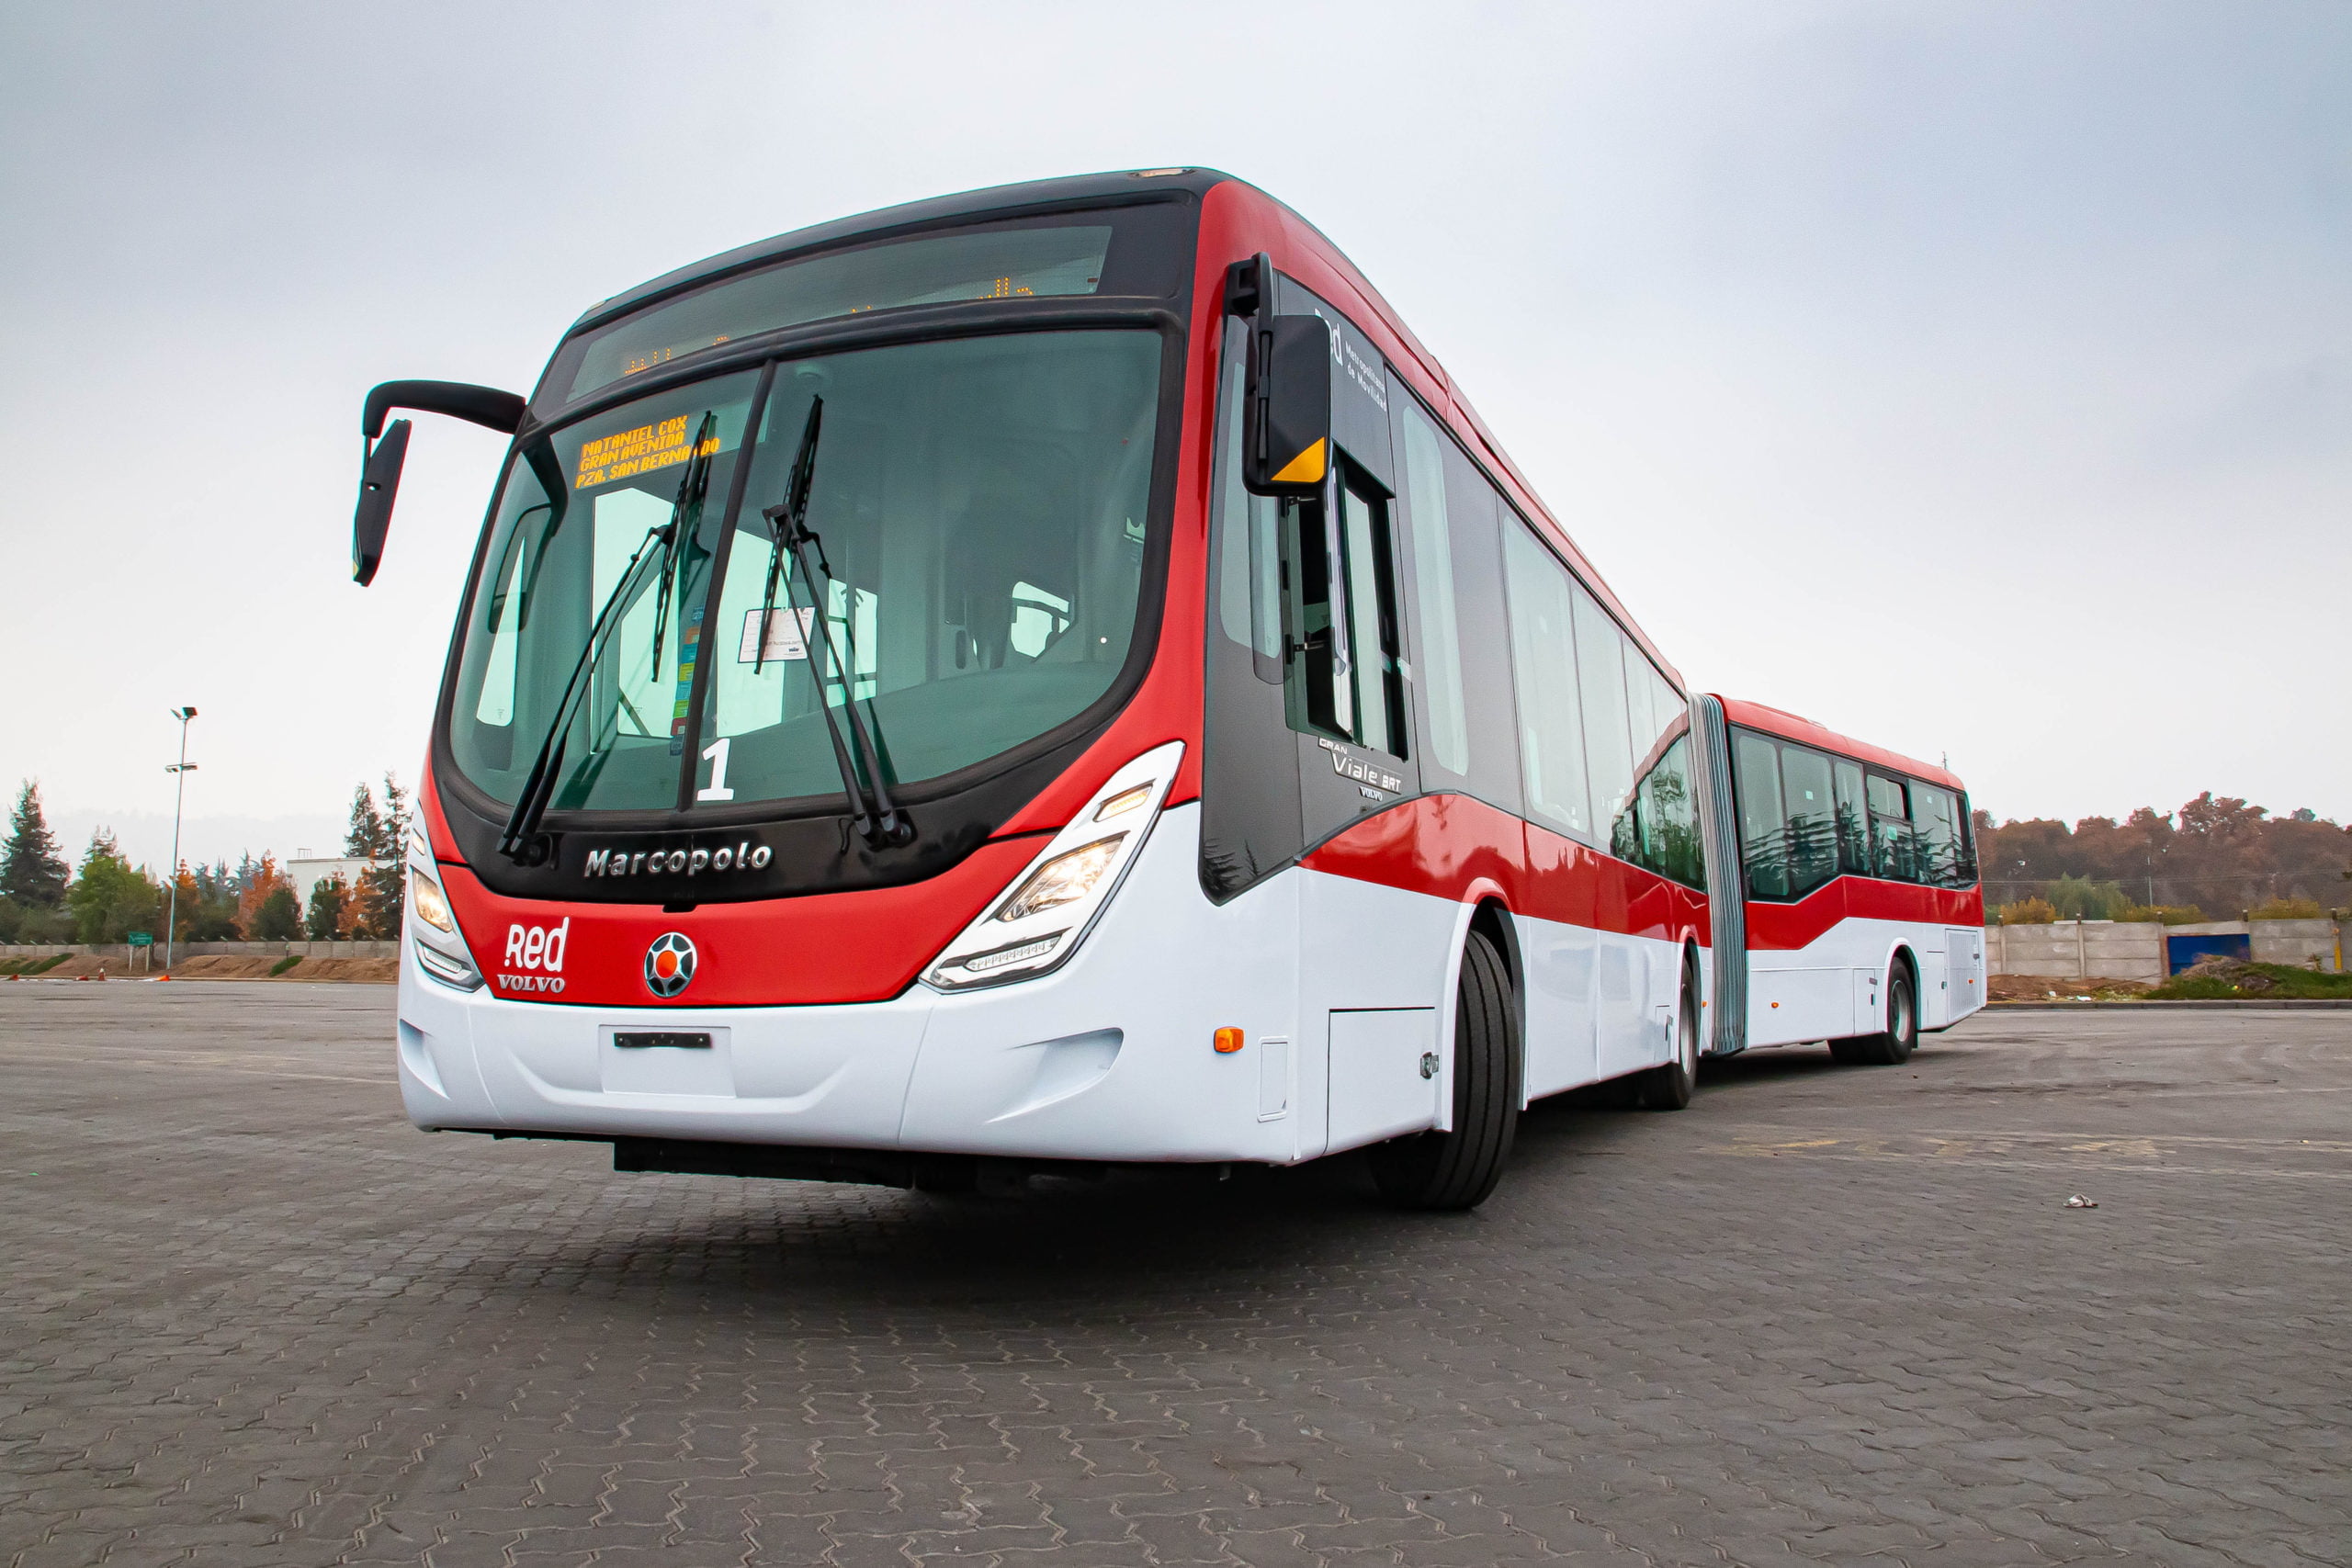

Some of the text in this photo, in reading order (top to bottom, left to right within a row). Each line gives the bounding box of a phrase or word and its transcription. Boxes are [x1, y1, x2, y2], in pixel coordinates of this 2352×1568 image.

[1345, 340, 1385, 394] Metropolitana
[1347, 362, 1387, 412] de Movilidad
[580, 431, 685, 473] GRAN AVENIDA
[582, 414, 688, 457] NATANIEL COX
[609, 460, 639, 479] SAN
[640, 436, 721, 472] BERNADO
[1318, 738, 1348, 755] GRAN
[696, 738, 735, 802] 1
[1332, 752, 1401, 792] Viale BRT
[1359, 785, 1383, 802] VOLVO
[584, 840, 774, 877] Marcopolo
[504, 917, 570, 973] Red
[497, 974, 566, 994] VOLVO
